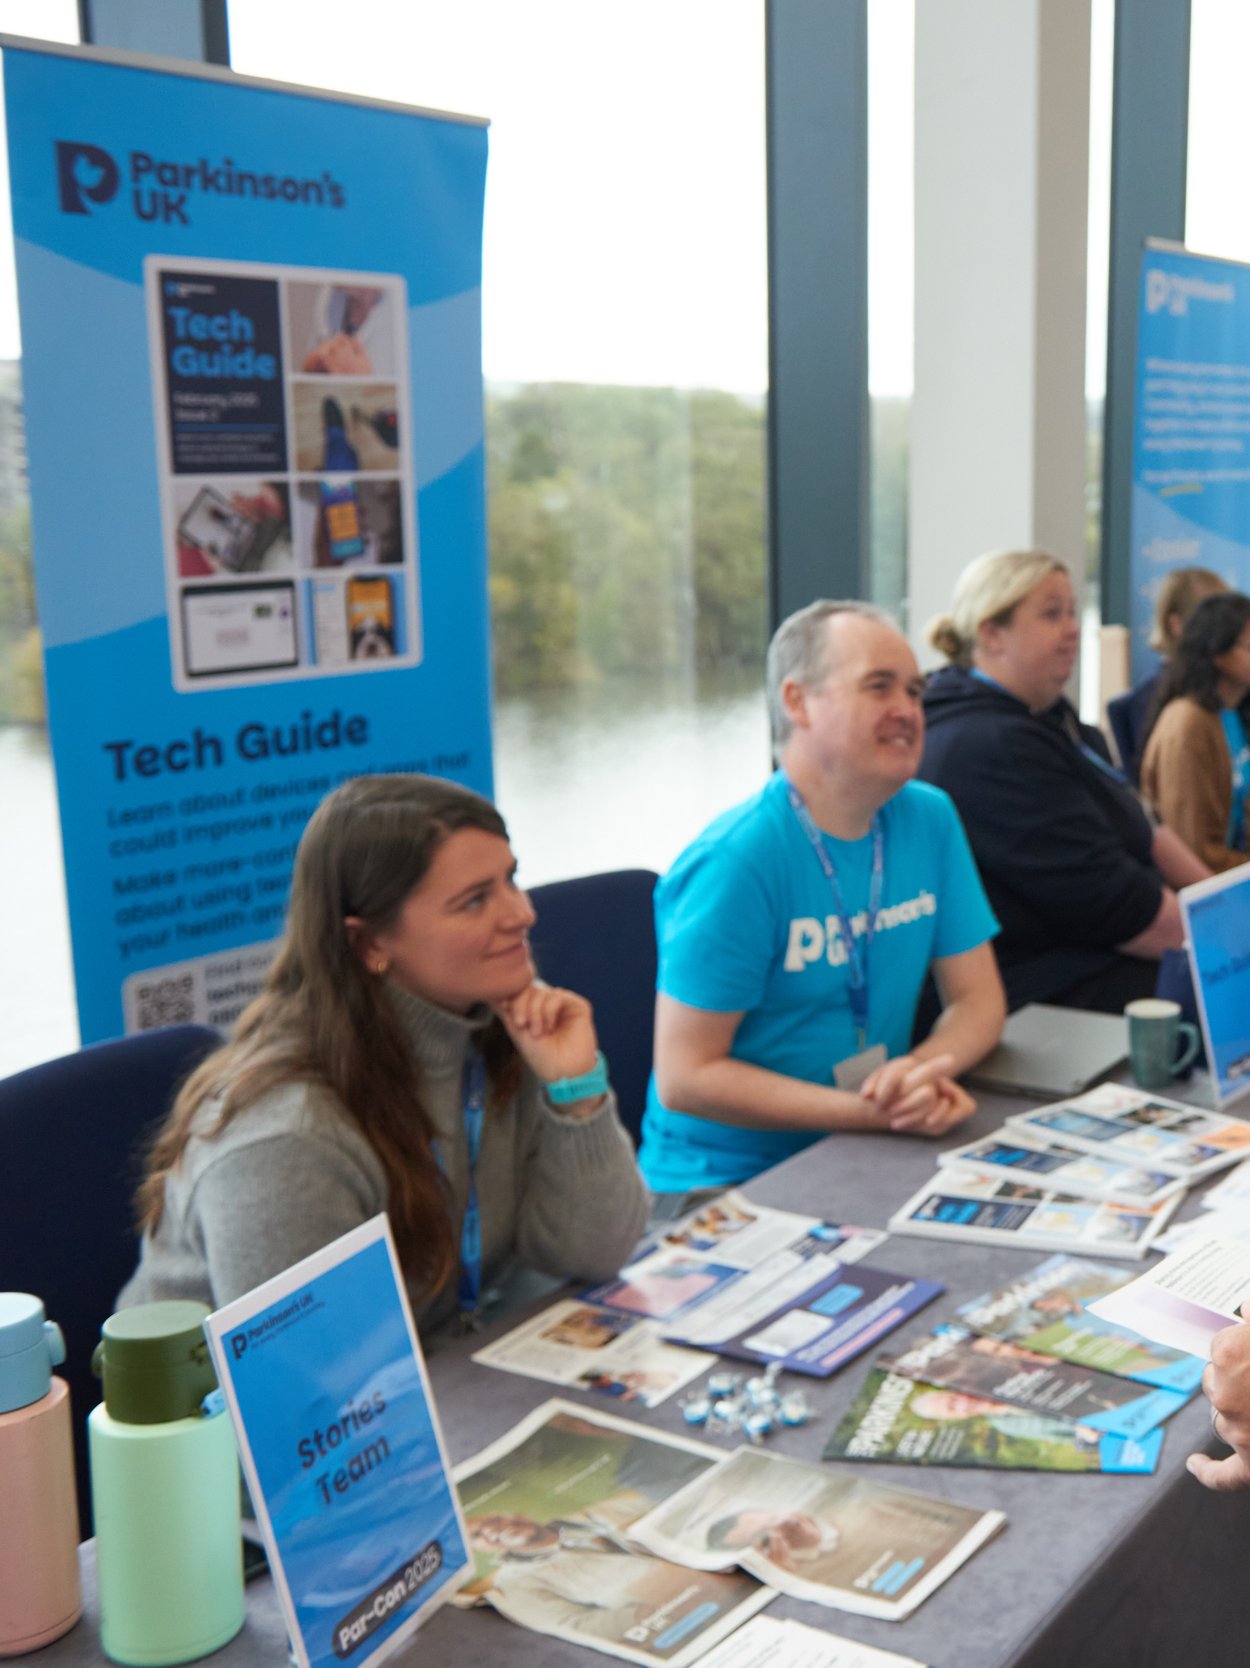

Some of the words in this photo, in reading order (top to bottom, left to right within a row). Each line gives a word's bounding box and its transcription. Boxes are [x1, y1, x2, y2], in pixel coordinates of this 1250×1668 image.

[129, 150, 346, 208] Parkinson's
[133, 189, 190, 227] UK
[167, 306, 254, 341] Tech
[171, 343, 276, 379] Guide
[104, 726, 224, 782] Tech
[236, 710, 370, 761] Guide
[106, 800, 175, 829] Learn
[177, 787, 247, 817] about
[249, 774, 330, 804] devices
[432, 752, 472, 771] that
[108, 826, 178, 858] could
[181, 812, 274, 845] improve
[278, 805, 311, 832] you
[112, 867, 178, 896] Make
[114, 894, 186, 927] about
[189, 881, 253, 911] using
[117, 926, 171, 959] your
[175, 908, 249, 940] health
[297, 1391, 386, 1469] Stories
[315, 1435, 390, 1504] Team
[339, 1580, 408, 1651] Par-Con
[404, 1544, 442, 1591] 2025
